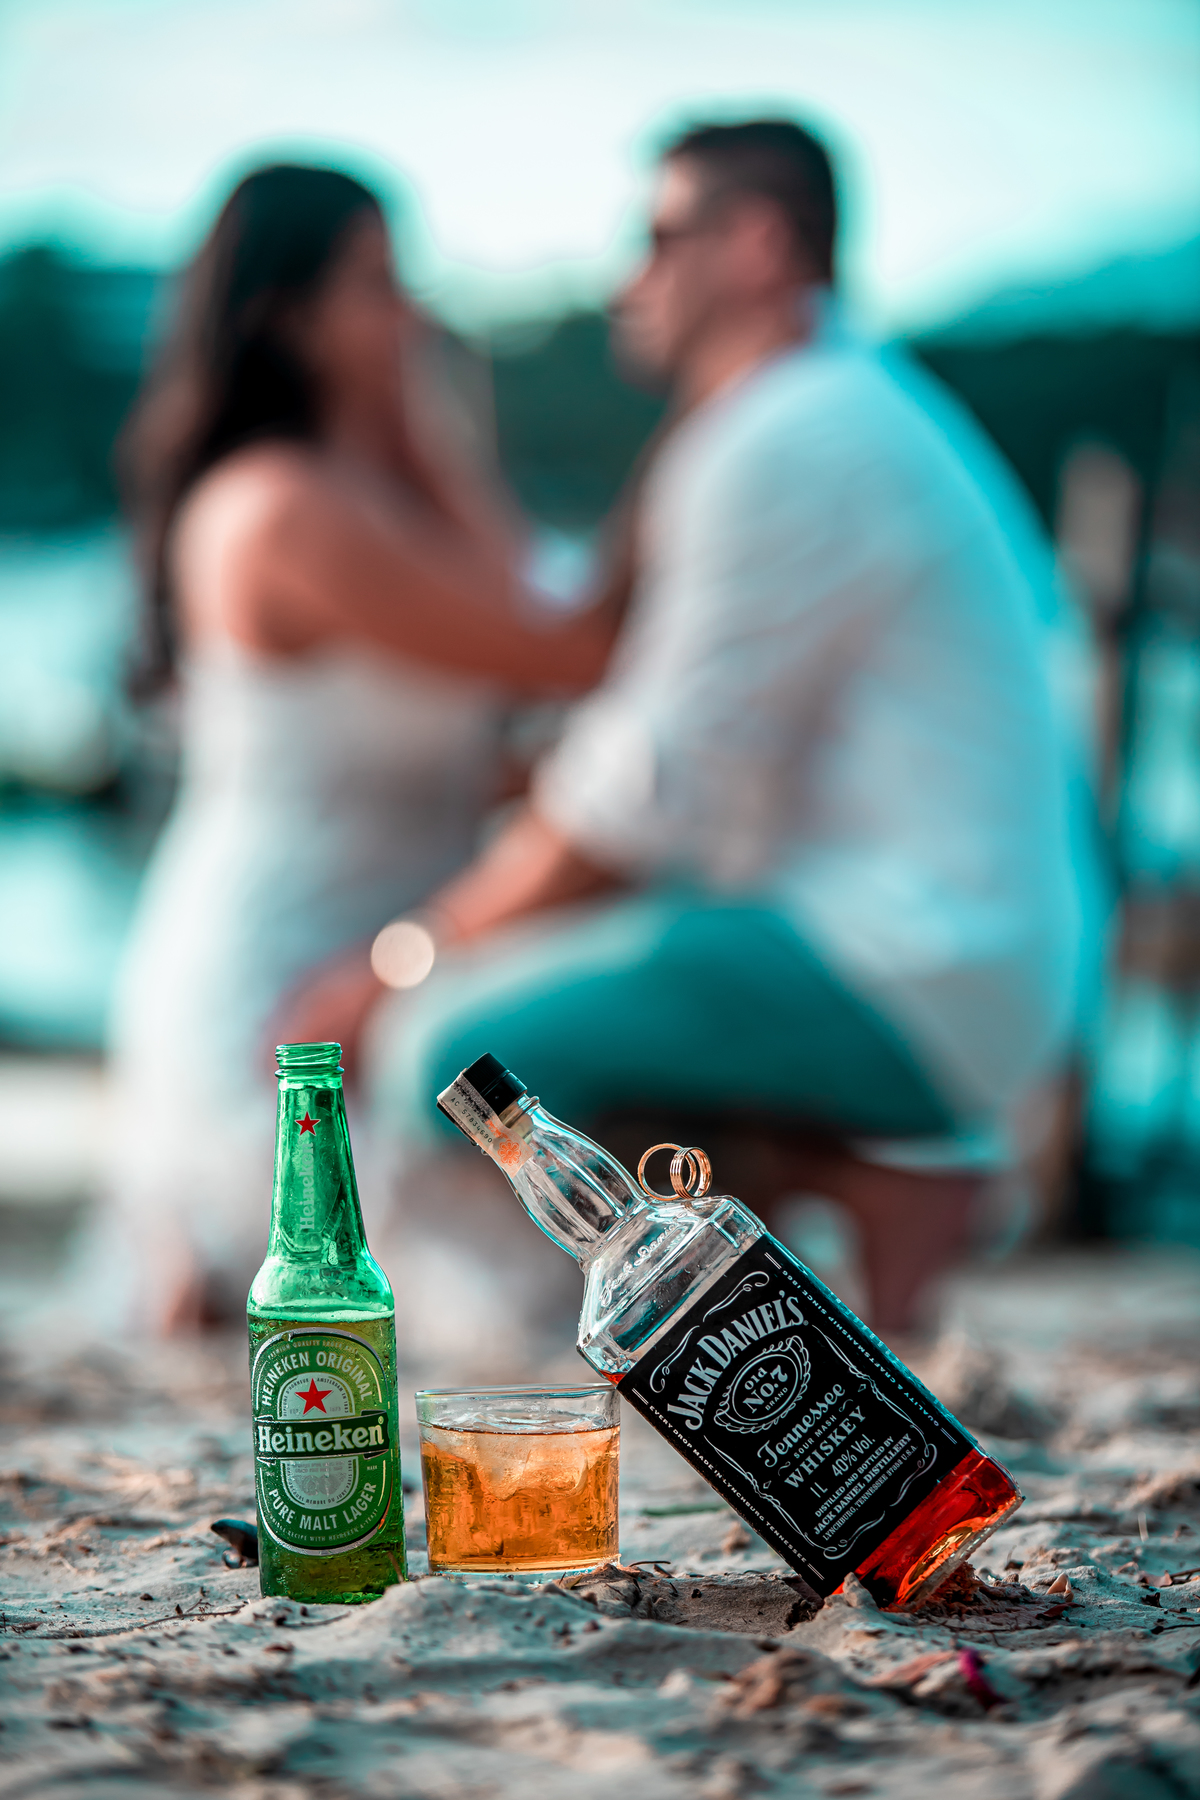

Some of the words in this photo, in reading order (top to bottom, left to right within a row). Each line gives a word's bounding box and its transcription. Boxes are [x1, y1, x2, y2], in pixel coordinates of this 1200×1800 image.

[450, 1097, 460, 1107] AC
[461, 1109, 493, 1143] 57834690
[299, 1142, 314, 1230] Heineken
[782, 1270, 801, 1289] 1866
[802, 1289, 827, 1315] SINCE
[667, 1357, 723, 1430] JACK
[696, 1290, 804, 1369] DANIEL'S
[828, 1316, 896, 1383] CRAFTSMANSHIP
[262, 1351, 310, 1406] HEINEKEN
[316, 1351, 372, 1401] ORIGINAL
[744, 1367, 767, 1390] Old
[765, 1387, 788, 1411] BRAND
[757, 1384, 845, 1467] Tennessee
[902, 1391, 939, 1427] QUALITY
[258, 1423, 384, 1453] Heineken
[784, 1406, 866, 1488] WHISKEY
[793, 1437, 815, 1459] SOUR
[814, 1415, 837, 1437] MASH
[831, 1449, 857, 1477] 40%
[851, 1434, 876, 1454] Vol.
[649, 1406, 673, 1429] EVERY
[673, 1429, 693, 1448] DROP
[693, 1449, 714, 1470] MADE
[714, 1470, 722, 1479] IN
[723, 1479, 765, 1521] LYNCHBURG
[766, 1522, 807, 1563] TENNESSEE
[813, 1511, 837, 1535] JACK
[833, 1482, 866, 1513] DANIEL
[863, 1433, 912, 1483] DISTILLERY
[815, 1486, 846, 1518] DISTILLED
[844, 1472, 859, 1488] AND
[857, 1446, 885, 1474] BOTTLED
[883, 1436, 894, 1448] BY
[855, 1473, 888, 1508] TENNESSEE
[268, 1488, 296, 1524] PURE
[299, 1514, 338, 1530] MALT
[342, 1482, 377, 1524] LAGER
